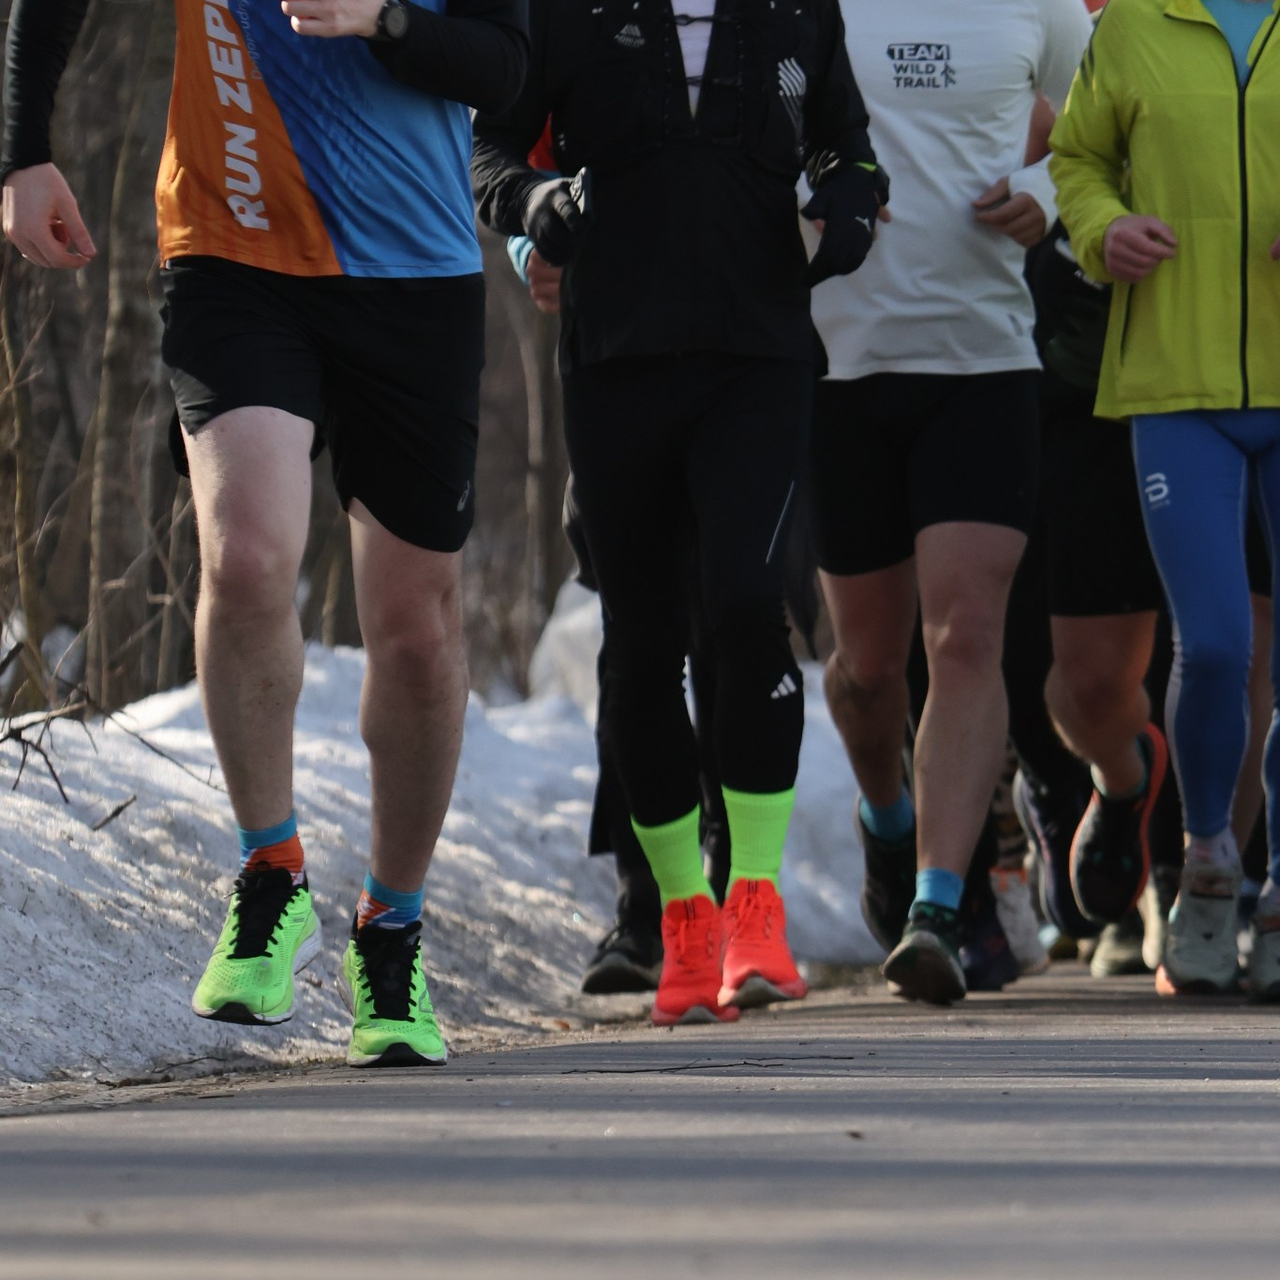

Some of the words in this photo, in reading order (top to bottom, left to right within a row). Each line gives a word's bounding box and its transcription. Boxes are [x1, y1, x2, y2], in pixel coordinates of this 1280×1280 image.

[888, 44, 948, 60] TEAM
[893, 63, 936, 74] WILD
[893, 76, 941, 88] TRAIL
[224, 121, 270, 232] RUN
